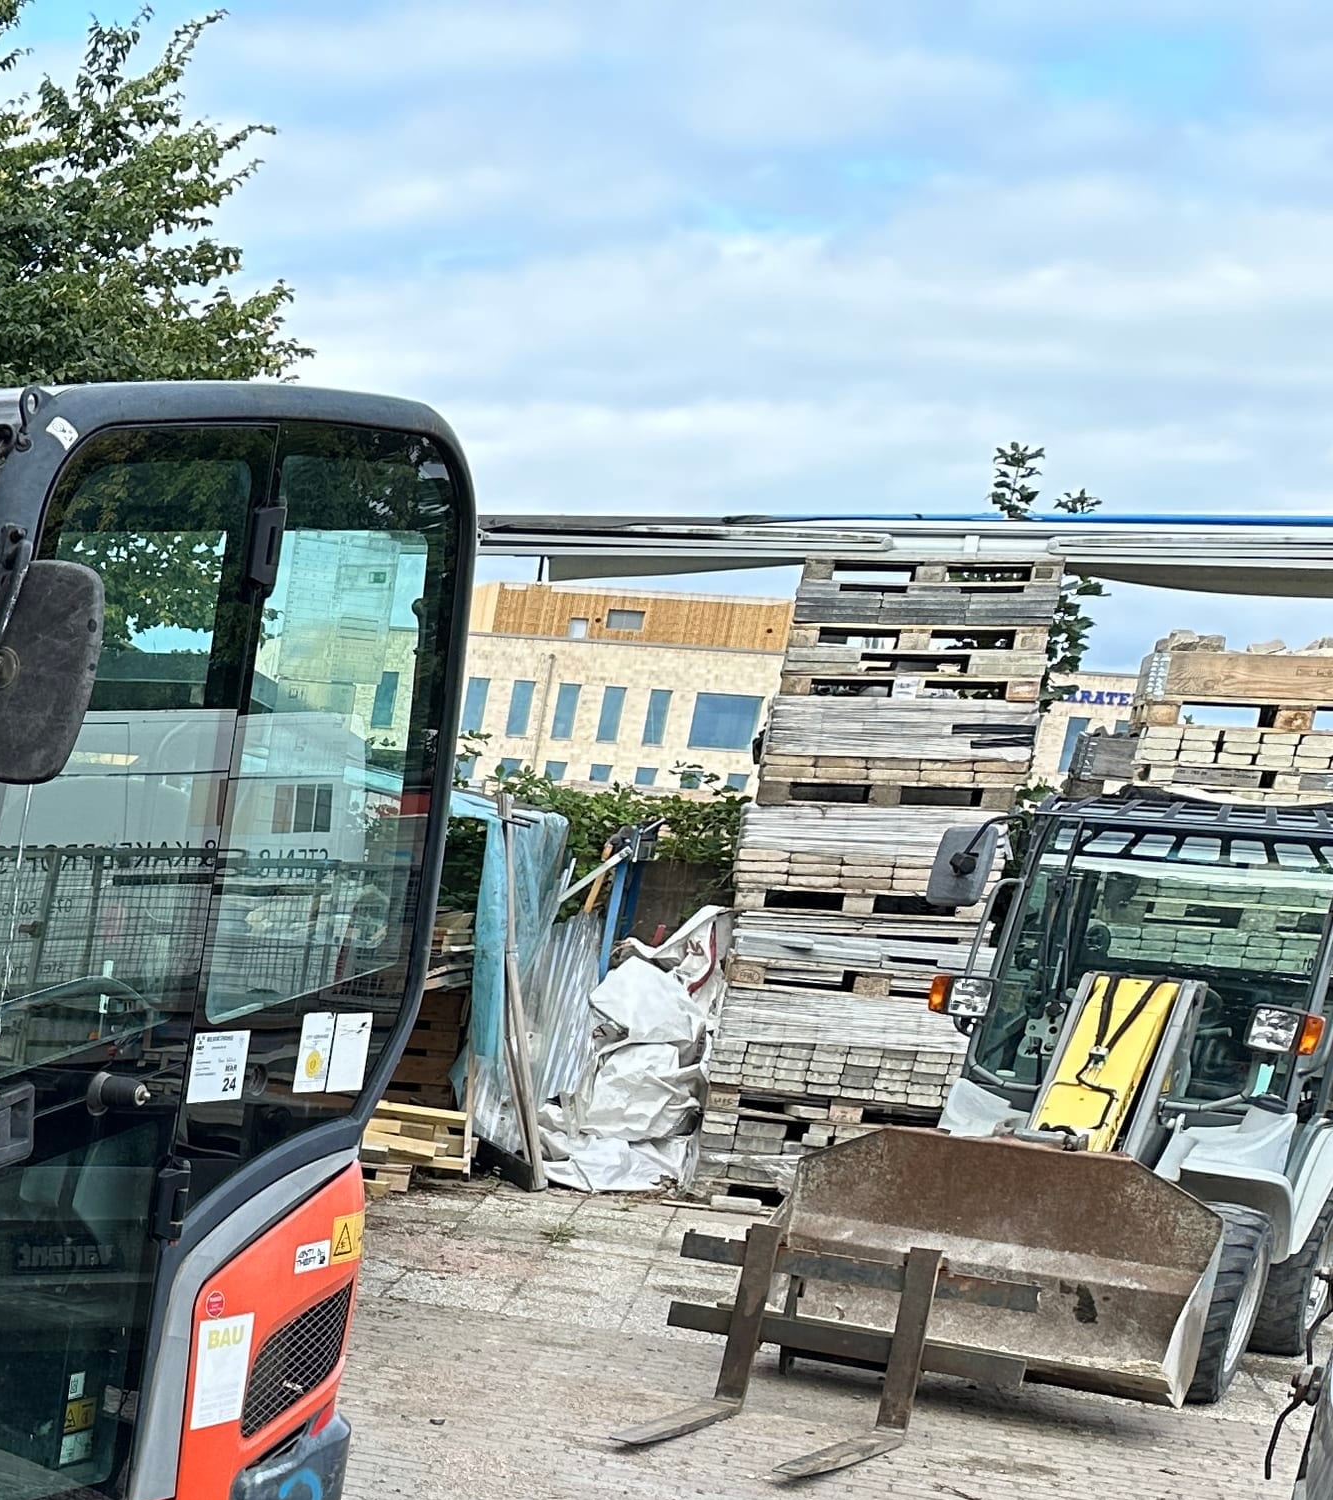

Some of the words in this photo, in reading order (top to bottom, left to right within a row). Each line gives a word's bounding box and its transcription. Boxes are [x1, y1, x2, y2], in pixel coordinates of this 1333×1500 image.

[1063, 689, 1135, 706] ARATE
[222, 1077, 237, 1092] 24
[207, 1325, 245, 1350] BAU
